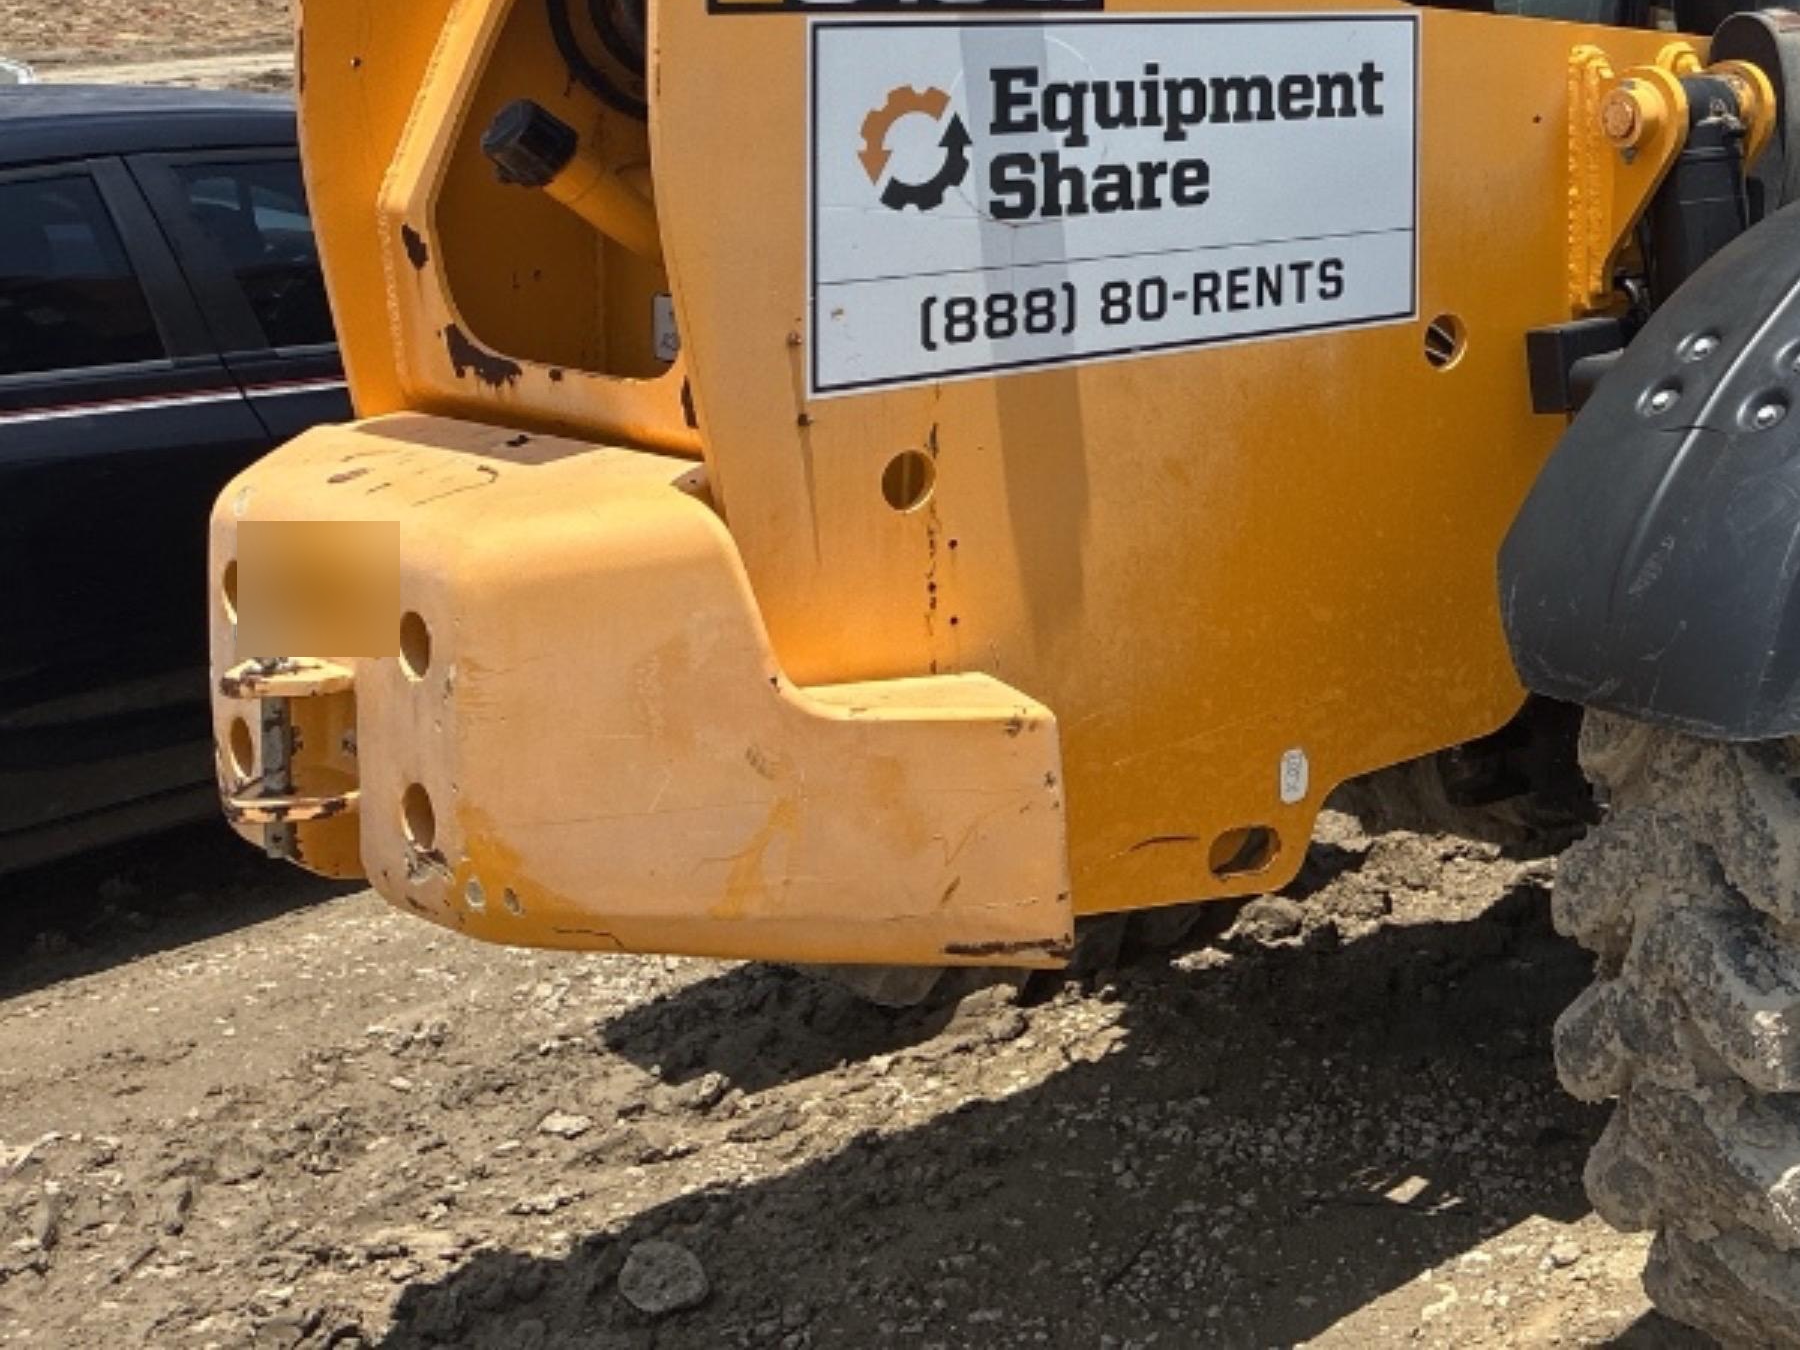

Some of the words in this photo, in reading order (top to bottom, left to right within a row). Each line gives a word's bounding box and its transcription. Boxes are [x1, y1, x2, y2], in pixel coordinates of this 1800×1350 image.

[988, 60, 1384, 147] Equipment
[988, 149, 1211, 221] Share
[920, 281, 1076, 352] (888)
[1099, 256, 1346, 326] 80-RENTS
